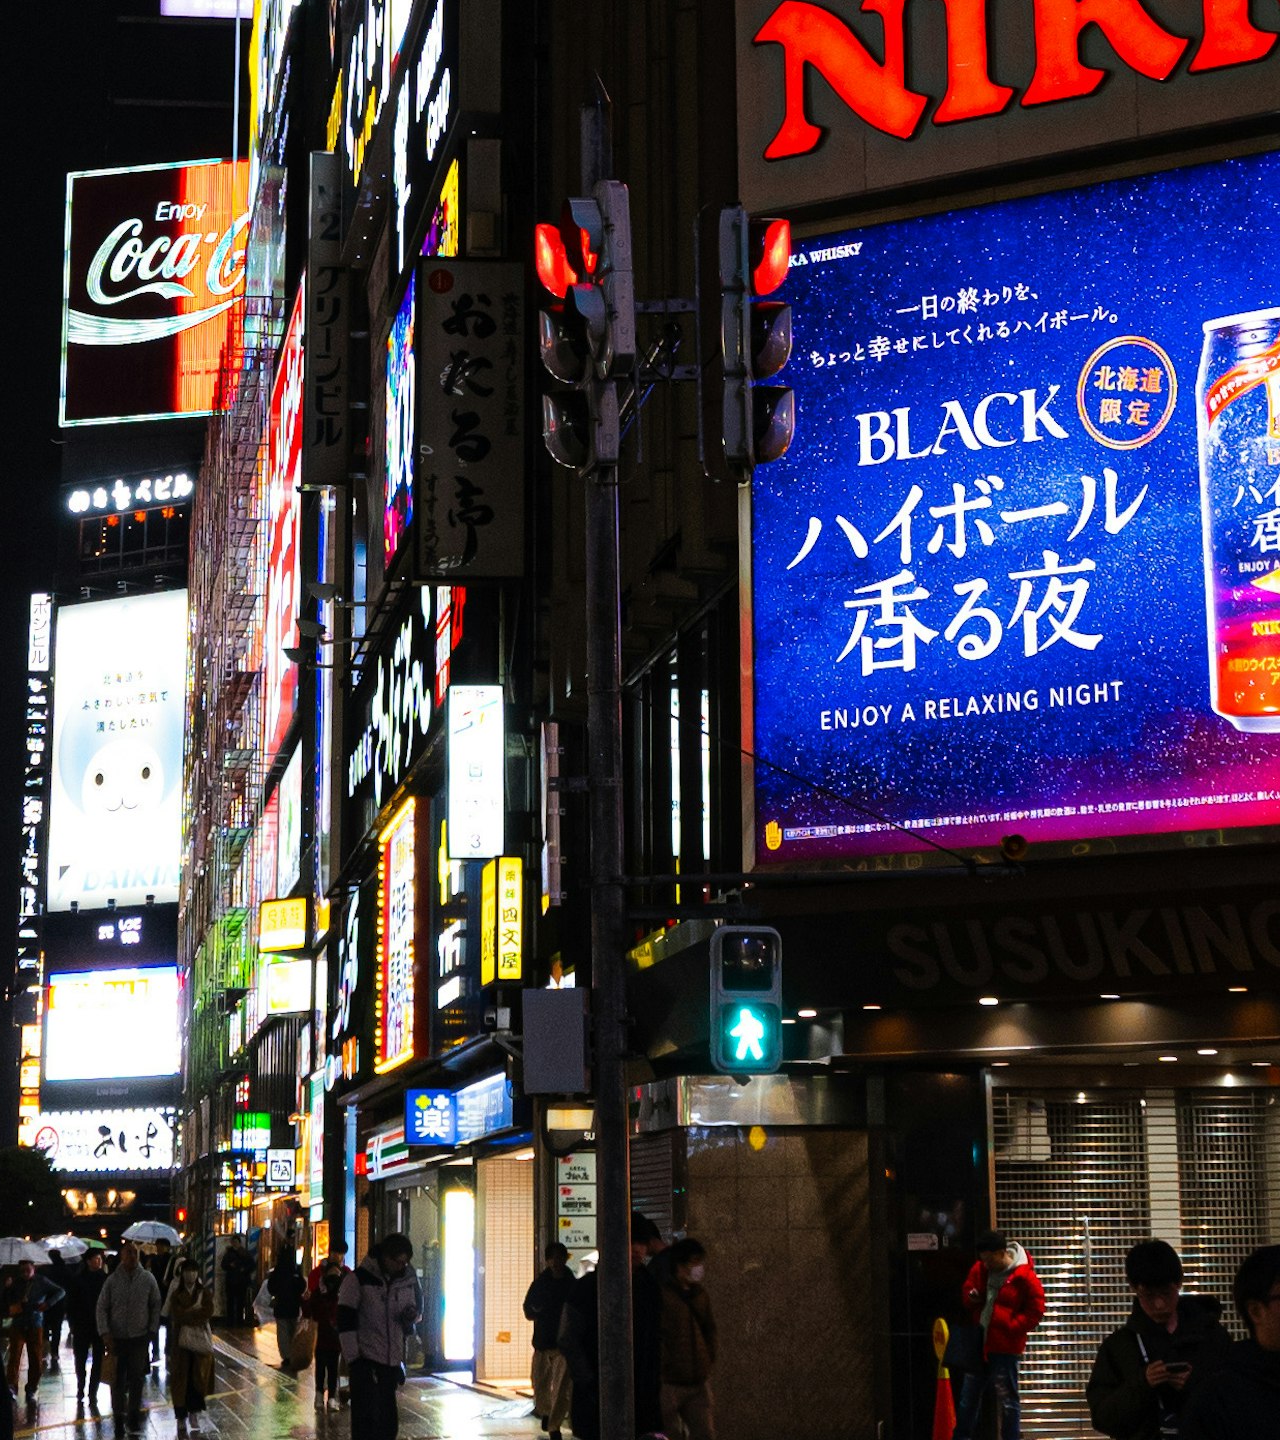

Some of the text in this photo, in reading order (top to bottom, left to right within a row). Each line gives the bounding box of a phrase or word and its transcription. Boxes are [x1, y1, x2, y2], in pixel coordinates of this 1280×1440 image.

[155, 199, 208, 224] Enjoy
[810, 241, 864, 265] WHISKY
[896, 283, 1039, 320] 一日の終わりを、
[810, 306, 1119, 369] ちょっと幸せにしてくれるハイボール。
[1094, 364, 1163, 394] 北海道
[855, 383, 1069, 468] BLACK
[1099, 397, 1152, 427] 限定
[786, 466, 1150, 572] ハイボール
[1238, 560, 1272, 574] ENJOY
[836, 549, 1104, 677] 香る夜
[821, 681, 1124, 731] ENJOY A RELAXING NIGHT
[469, 834, 482, 850] 3
[82, 863, 183, 893] DAIKIN
[501, 906, 520, 970] 四文屋
